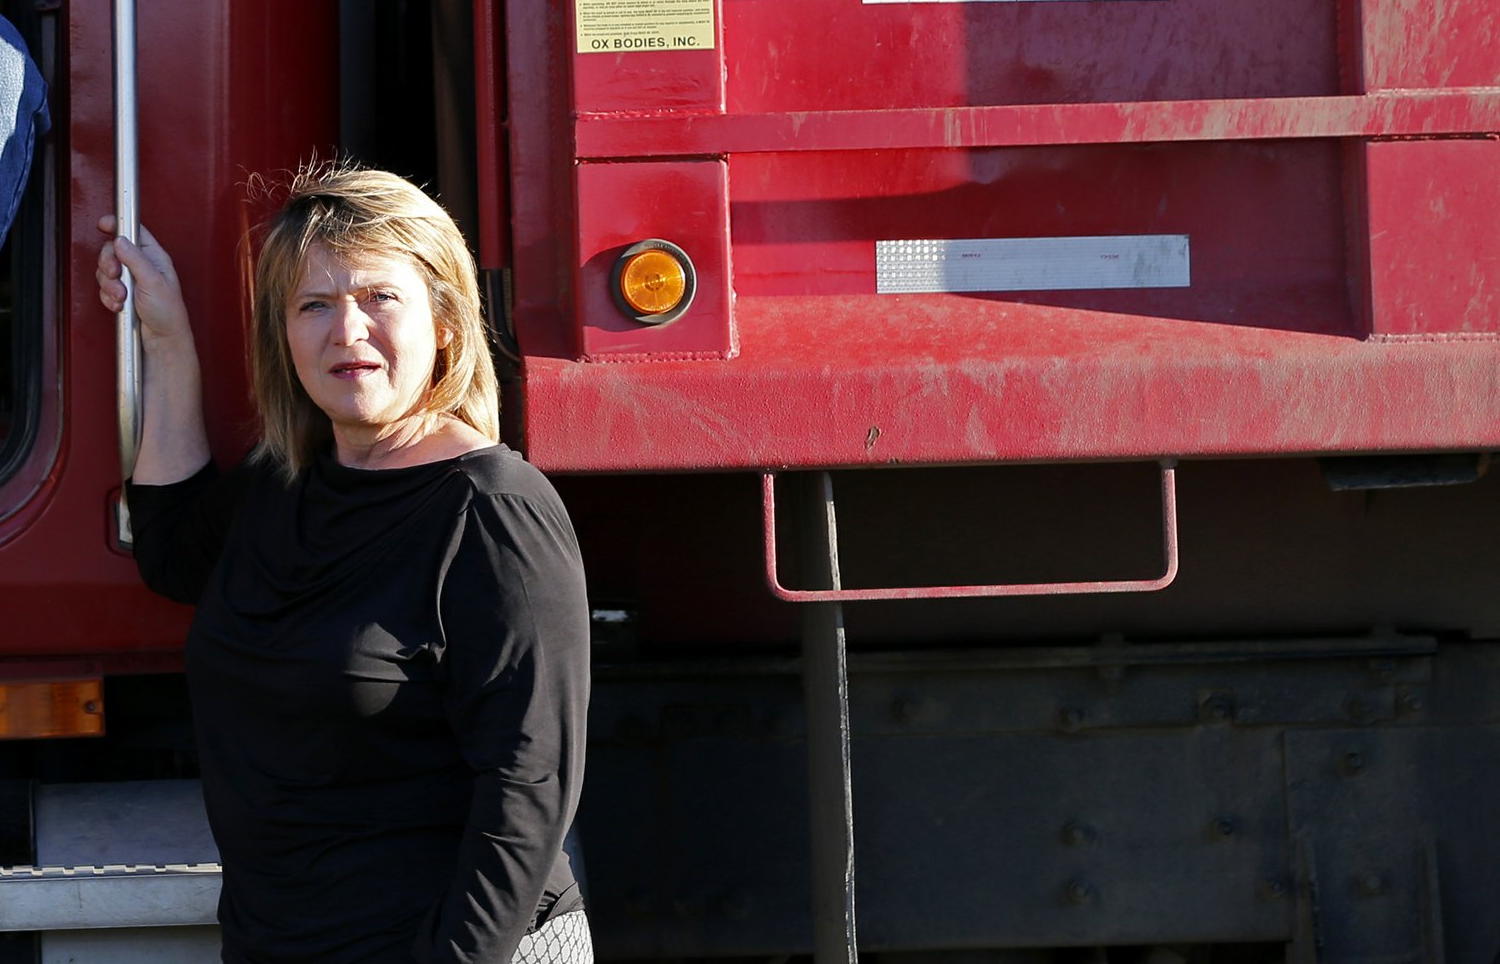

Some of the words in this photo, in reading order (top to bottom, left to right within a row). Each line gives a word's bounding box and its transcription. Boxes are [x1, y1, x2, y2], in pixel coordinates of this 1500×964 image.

[591, 38, 610, 50] OX
[614, 37, 670, 49] BODIES,
[673, 36, 701, 47] INC.
